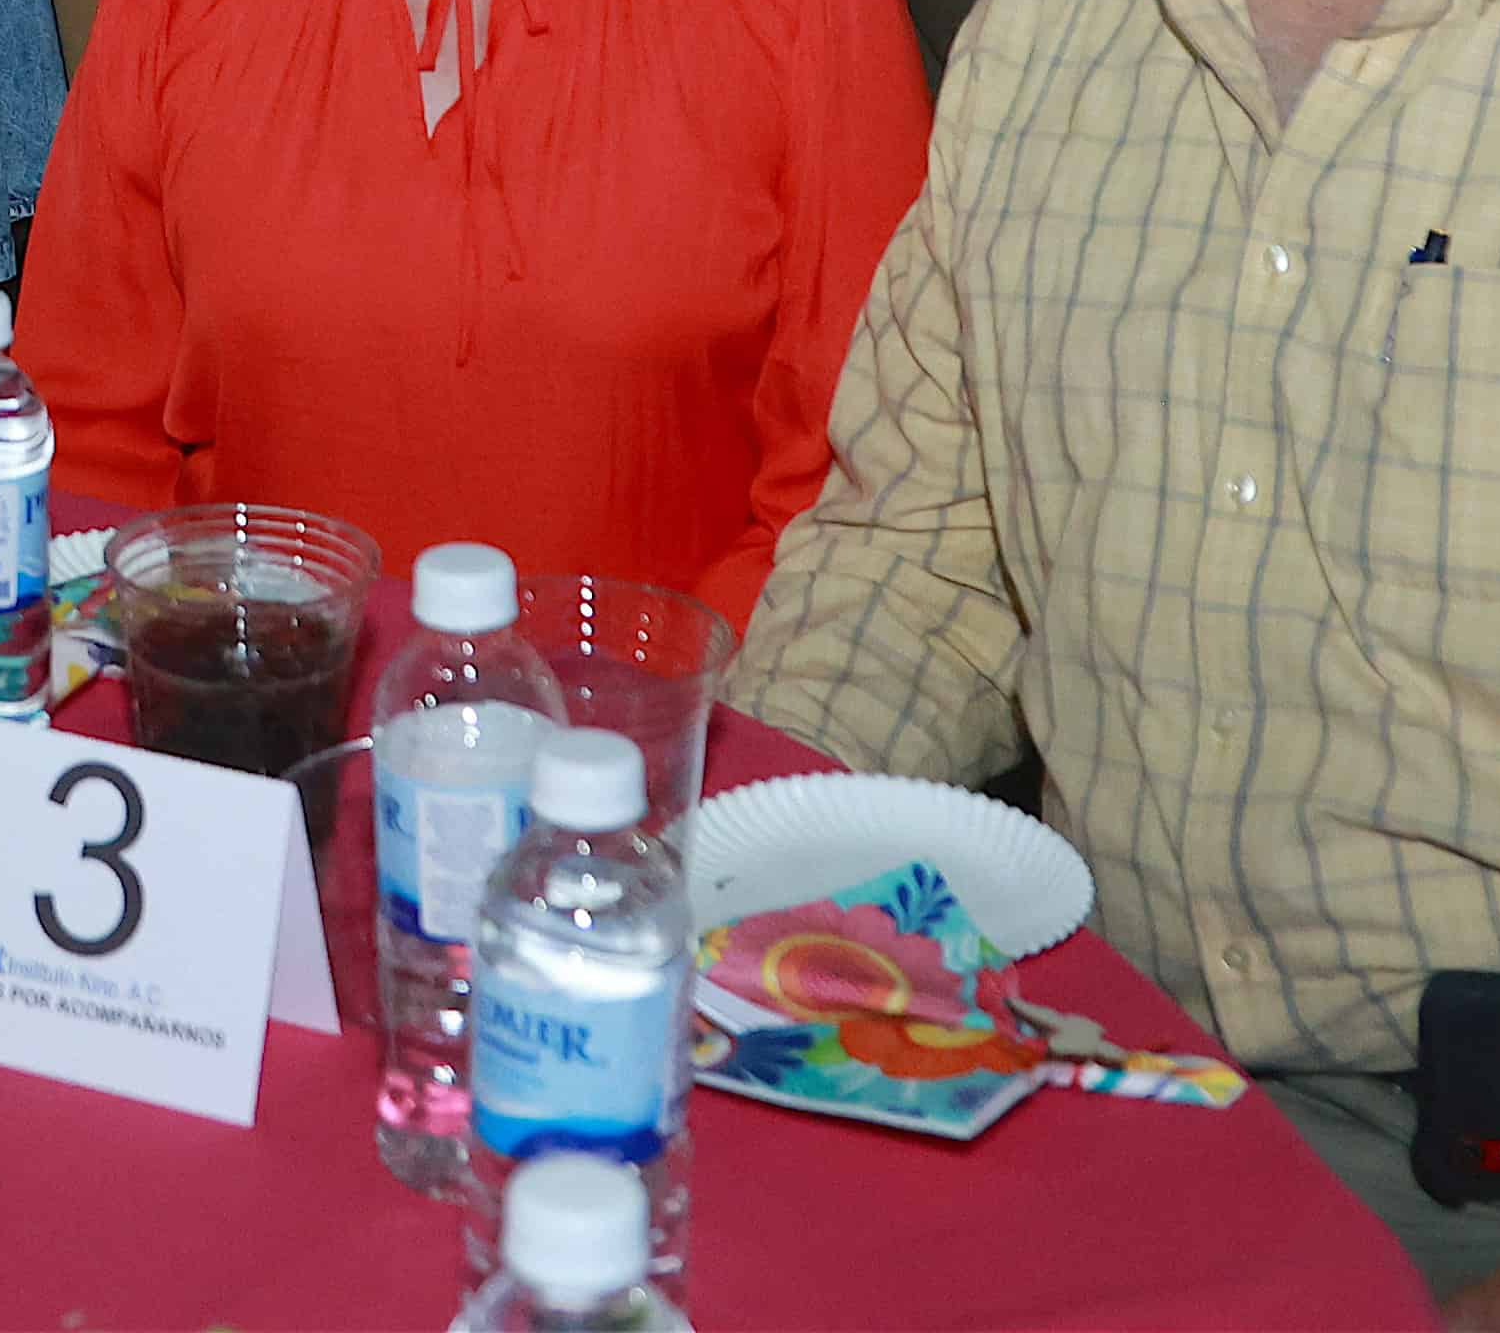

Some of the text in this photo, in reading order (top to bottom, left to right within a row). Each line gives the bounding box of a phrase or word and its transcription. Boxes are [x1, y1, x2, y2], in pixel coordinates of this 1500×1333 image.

[34, 761, 143, 955] 3
[8, 986, 51, 1011] POR
[58, 998, 227, 1049] ACOMPAÑARNOS
